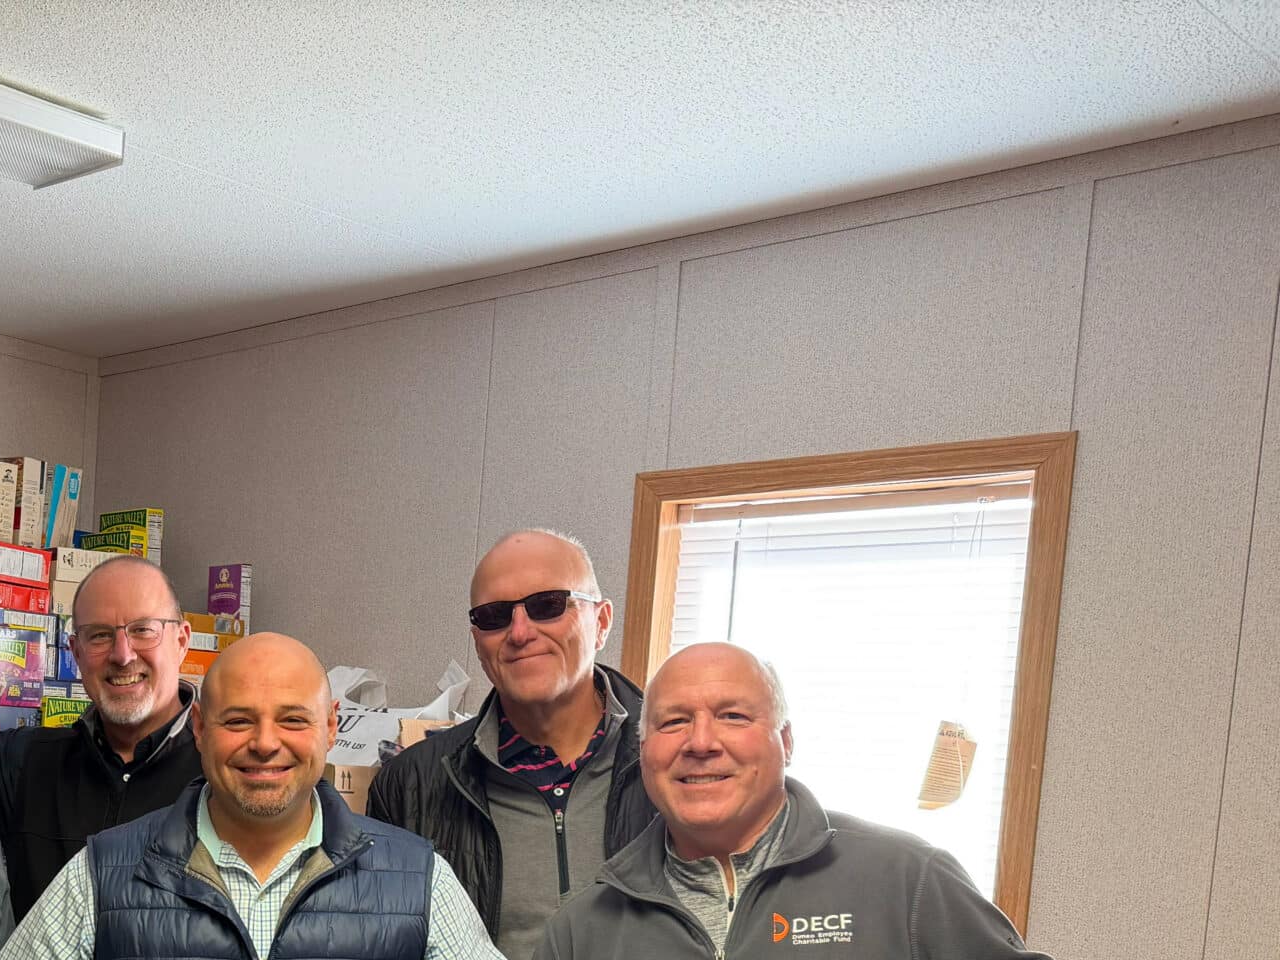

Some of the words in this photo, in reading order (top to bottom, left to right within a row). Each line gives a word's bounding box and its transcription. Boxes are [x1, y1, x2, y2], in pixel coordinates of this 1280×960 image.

[100, 513, 123, 527] NATURE
[123, 509, 146, 526] VALLEY
[82, 535, 104, 548] NATURE
[104, 532, 130, 547] VALLEY
[0, 641, 25, 657] VALLEY
[48, 698, 76, 717] NATURE
[59, 713, 80, 723] CRUN
[792, 913, 853, 933] DECF
[792, 937, 831, 945] Charitable
